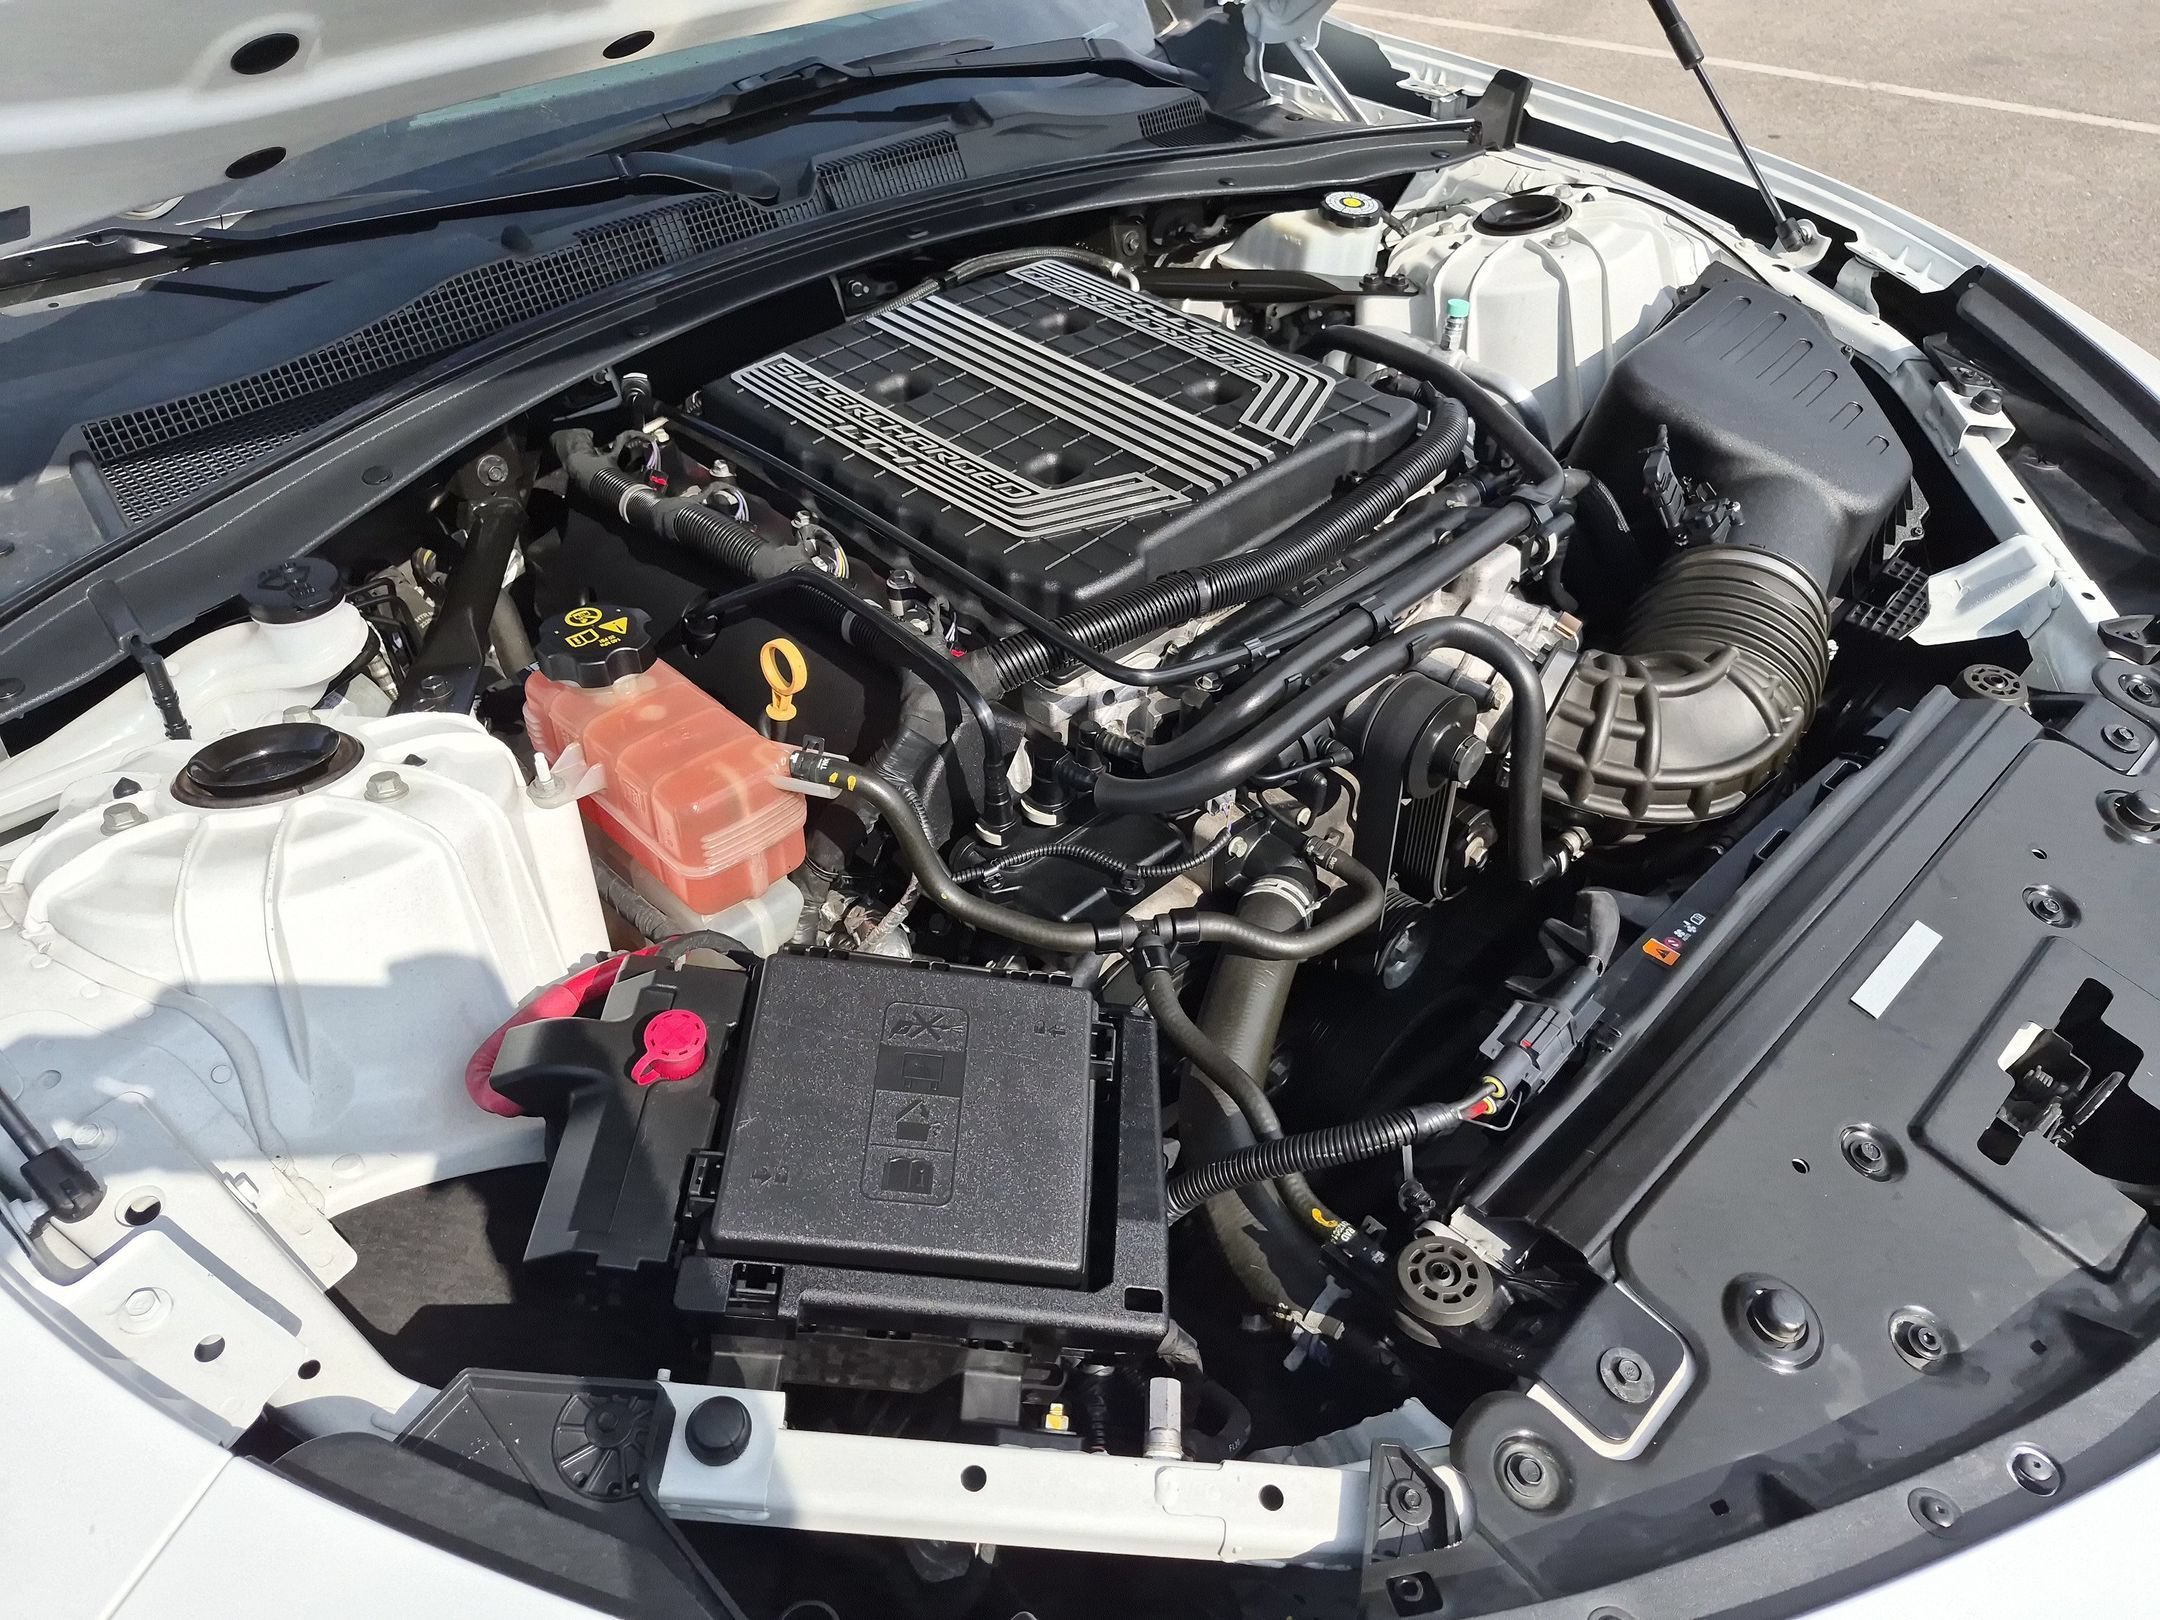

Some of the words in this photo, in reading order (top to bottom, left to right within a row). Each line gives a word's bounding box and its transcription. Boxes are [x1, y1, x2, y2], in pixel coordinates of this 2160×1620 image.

[1025, 269, 1268, 380] SUPERCHARGED
[1132, 301, 1214, 339] LT4
[766, 360, 1034, 499] SUPERCHARGED
[834, 423, 919, 470] LT4
[1341, 1226, 1356, 1242] RAD
